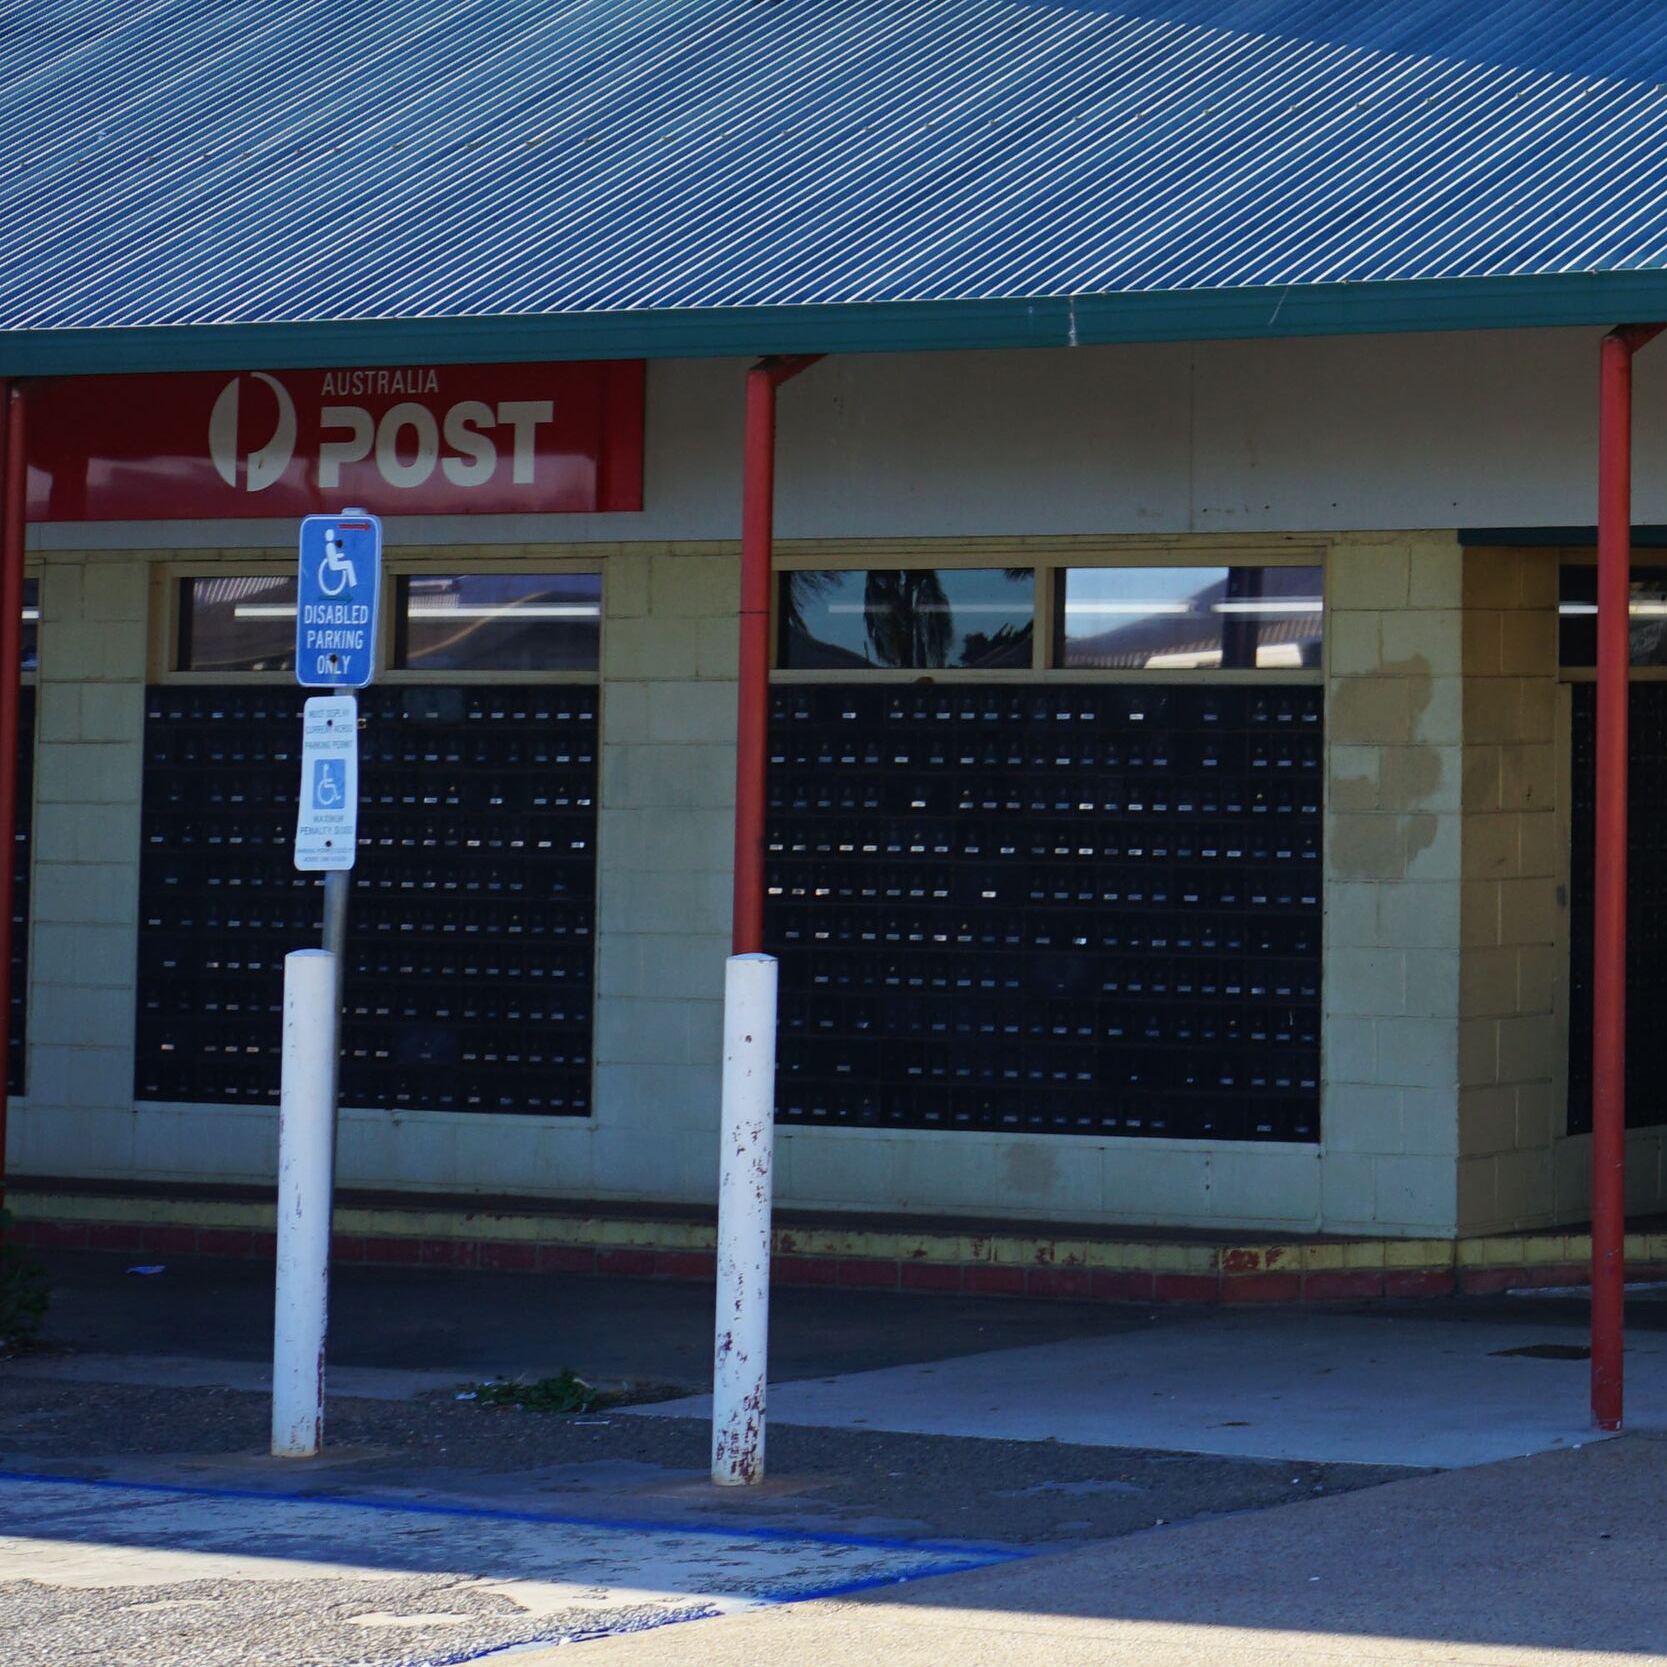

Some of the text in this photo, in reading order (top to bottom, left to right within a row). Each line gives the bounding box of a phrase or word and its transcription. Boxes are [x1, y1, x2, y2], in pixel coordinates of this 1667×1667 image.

[321, 369, 439, 397] AUSTRALIA
[318, 401, 554, 489] POST
[304, 605, 369, 625] DISABLED
[307, 630, 364, 650] PARKING
[317, 655, 351, 675] ONLY
